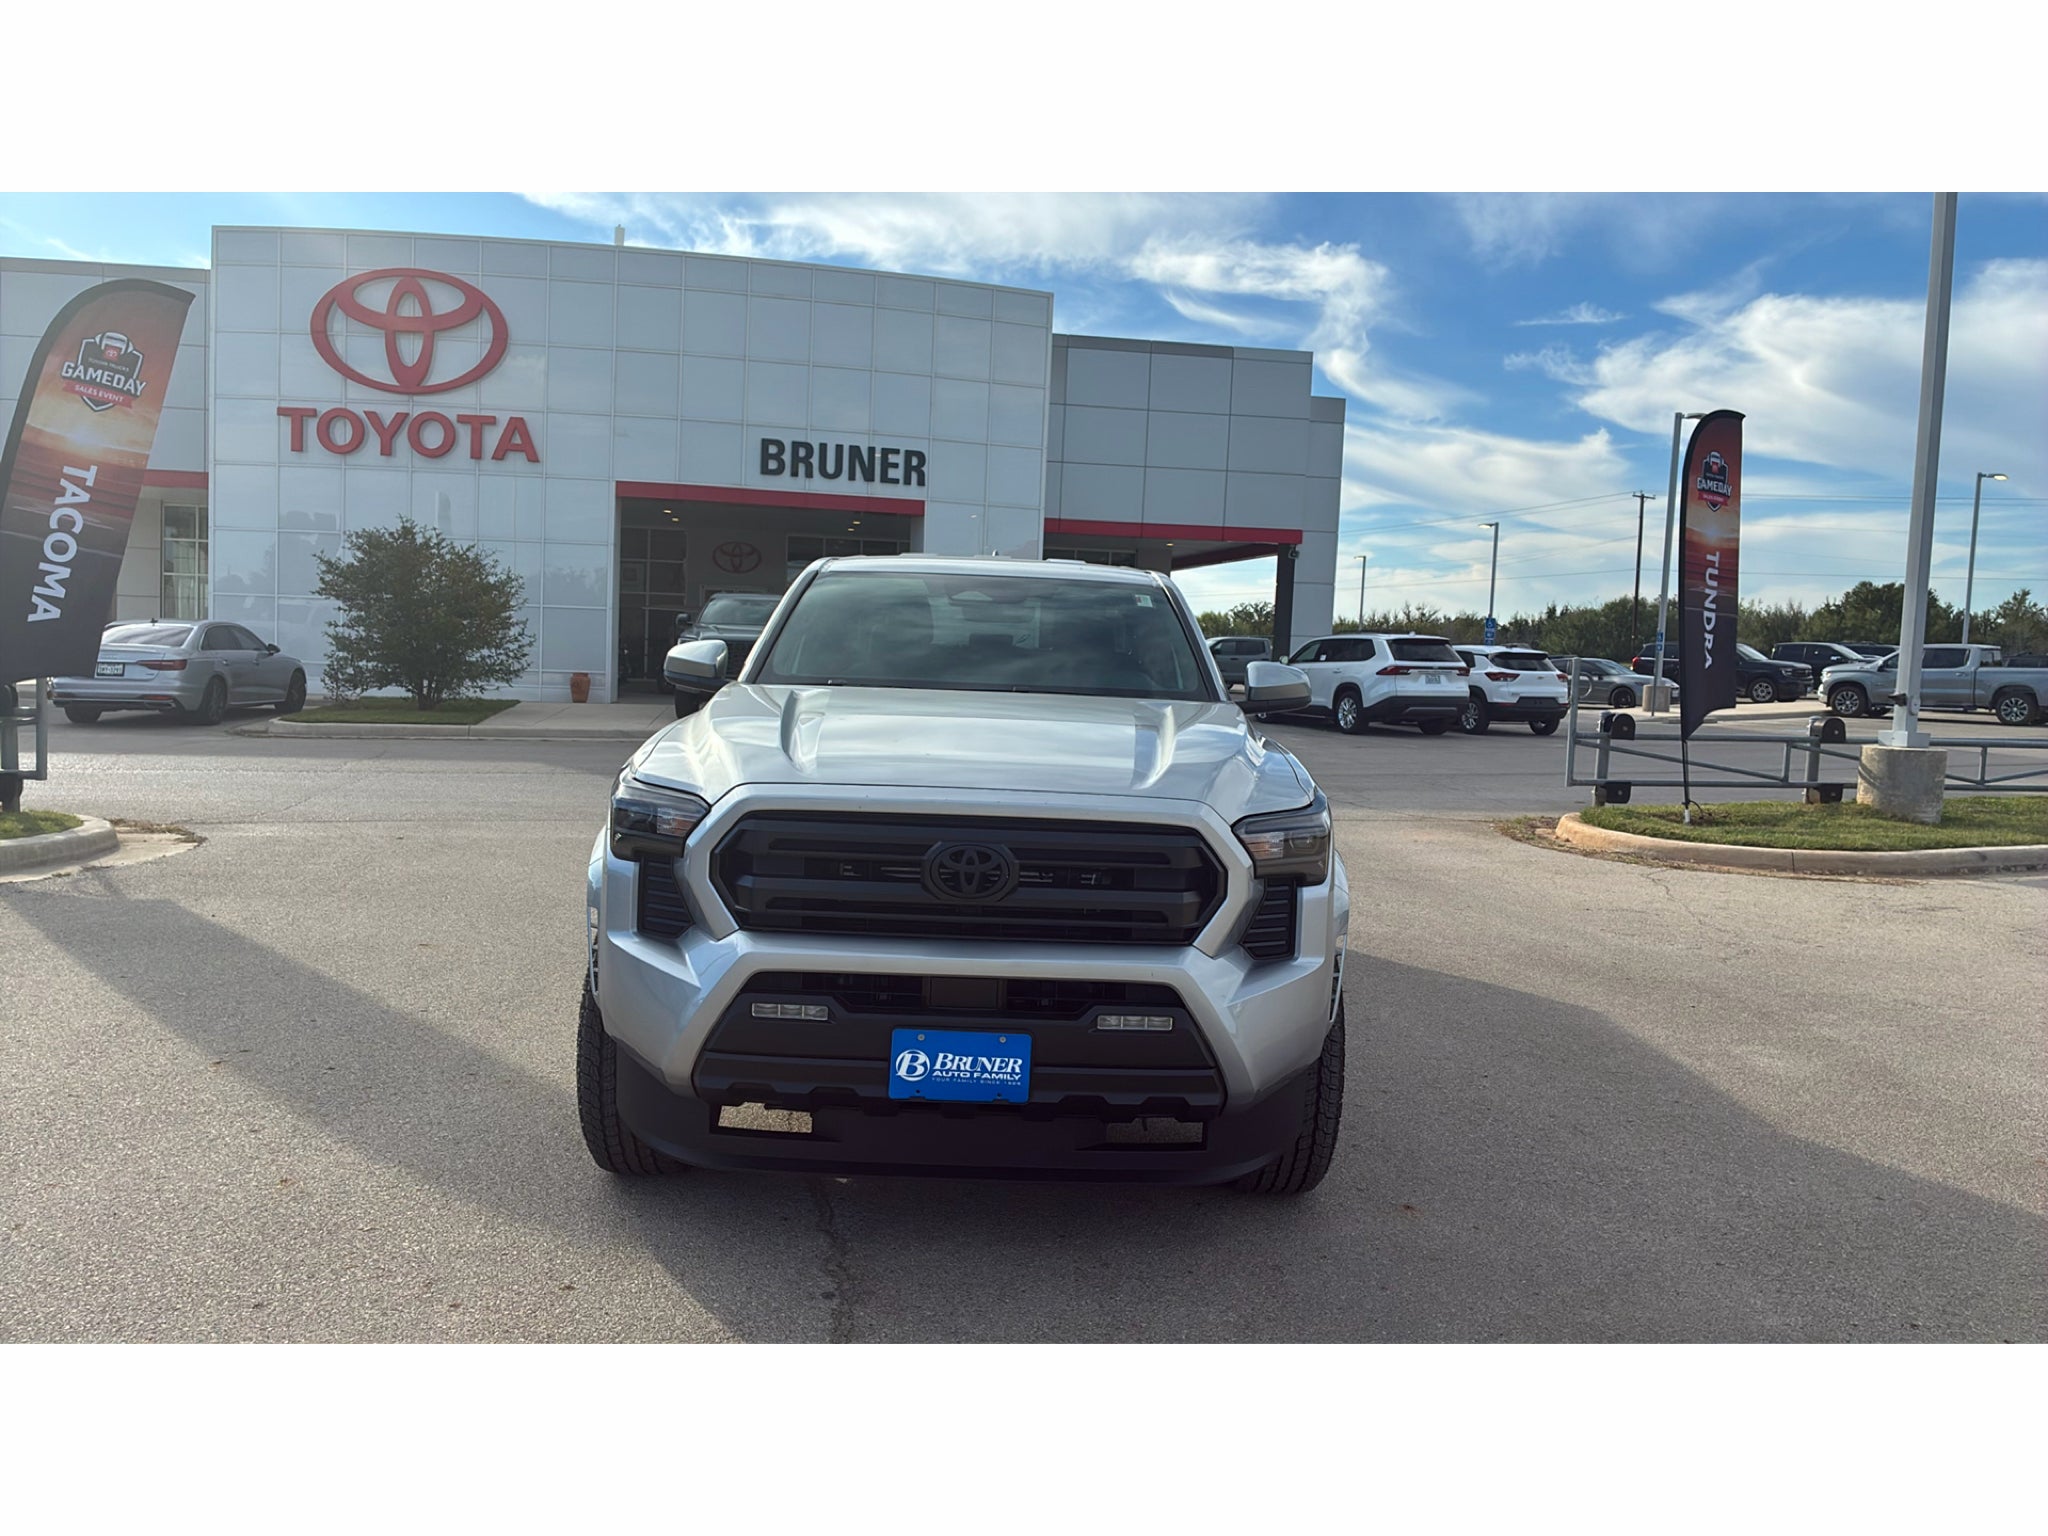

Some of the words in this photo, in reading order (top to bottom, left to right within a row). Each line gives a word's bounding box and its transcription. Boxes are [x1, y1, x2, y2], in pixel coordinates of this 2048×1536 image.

[61, 361, 147, 396] GAMEDAY
[75, 384, 98, 396] SALES
[99, 391, 125, 402] EVENT
[277, 406, 540, 463] TOYOTA
[760, 438, 927, 487] BRUNER
[1696, 477, 1732, 497] GAMEDAY
[27, 465, 98, 622] TACOMA
[1703, 551, 1720, 669] TUNDRA
[932, 1070, 970, 1078] AUTO
[973, 1072, 1022, 1081] FAMILY
[933, 1052, 1023, 1074] BRUNER
